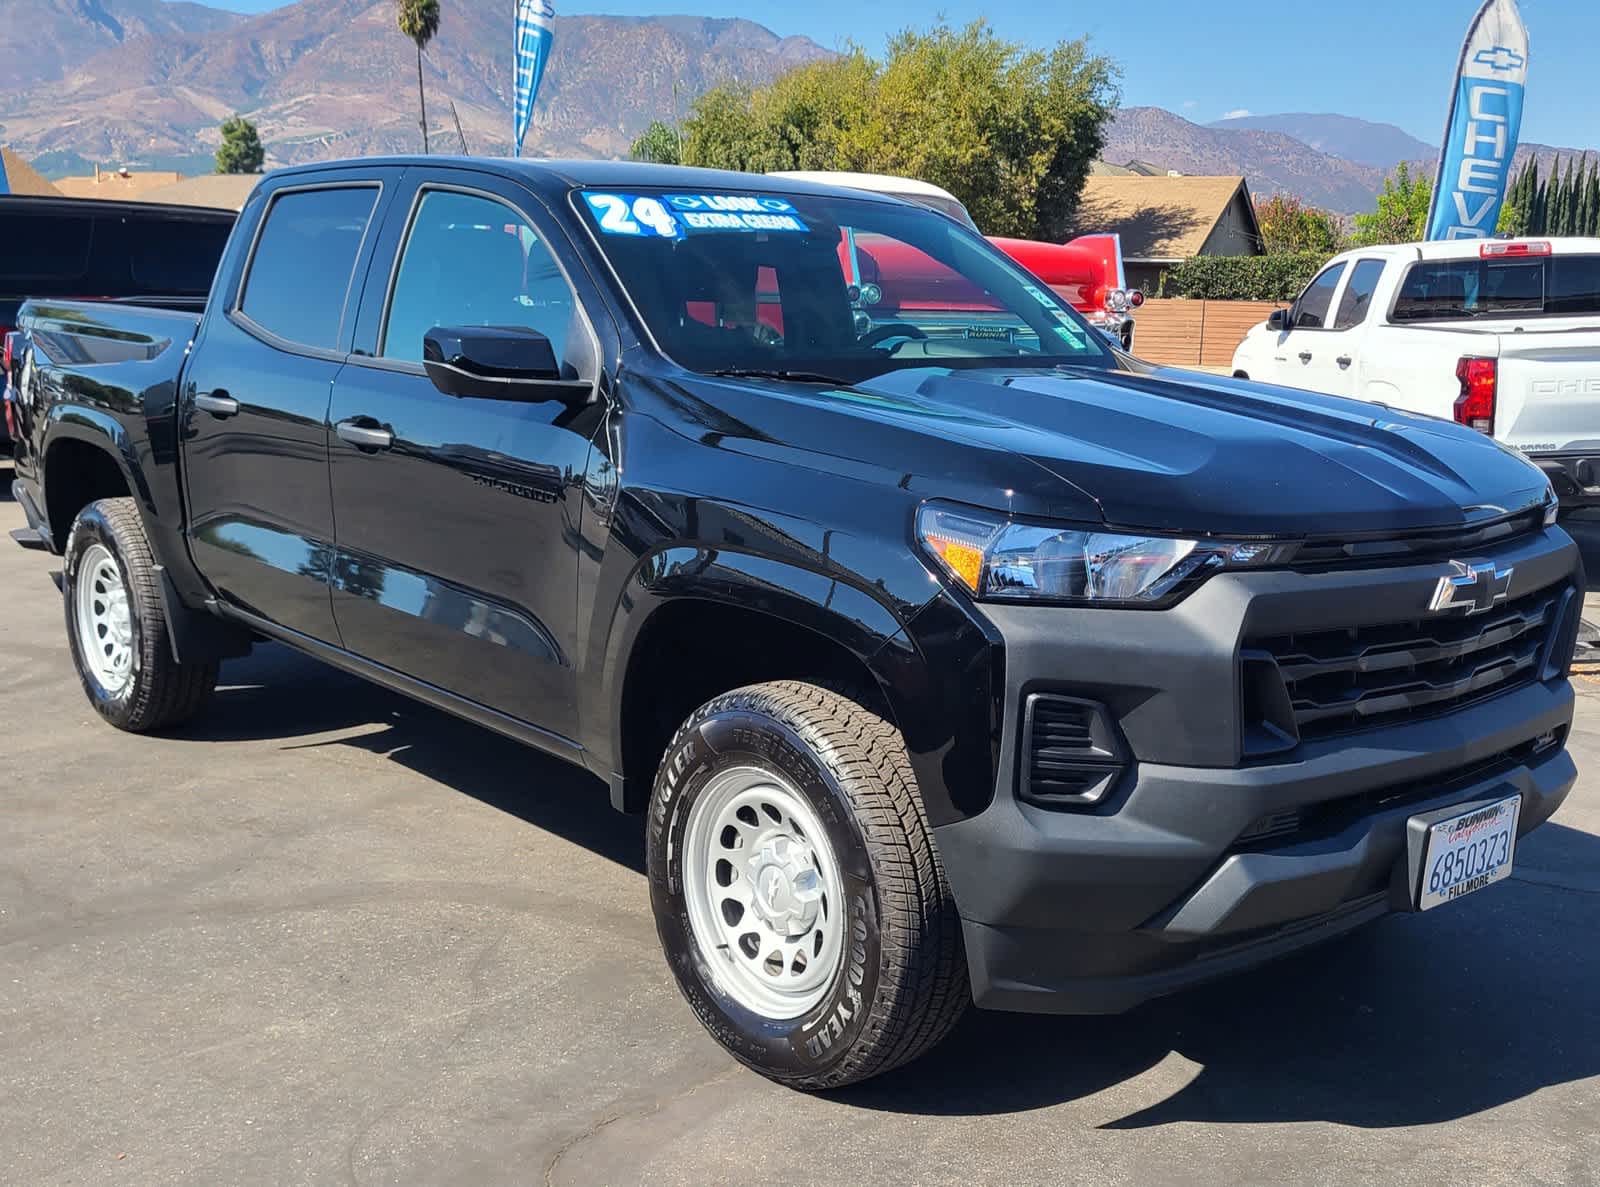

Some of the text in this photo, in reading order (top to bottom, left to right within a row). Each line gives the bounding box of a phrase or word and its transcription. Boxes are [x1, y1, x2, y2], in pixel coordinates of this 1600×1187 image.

[588, 194, 678, 238] 24
[699, 195, 769, 212] LOOK
[683, 212, 802, 231] EXTRA CLEAN
[1456, 805, 1499, 831] BUNNIN
[1448, 873, 1490, 900] FILLMORE
